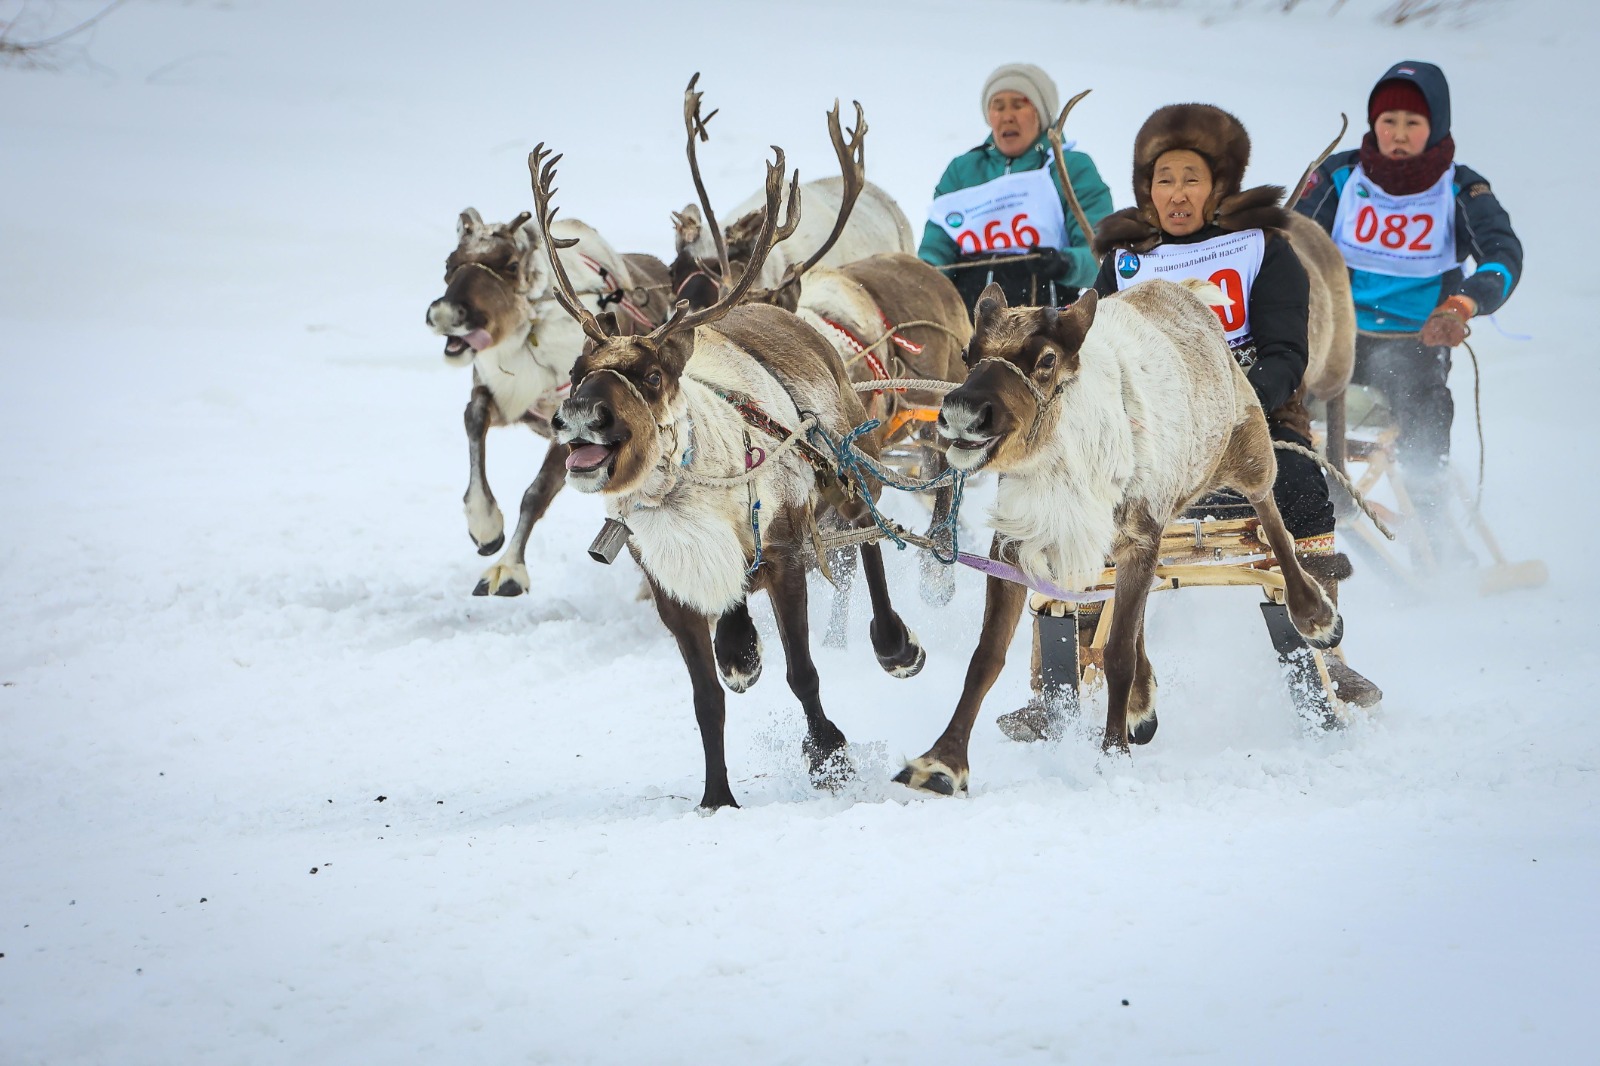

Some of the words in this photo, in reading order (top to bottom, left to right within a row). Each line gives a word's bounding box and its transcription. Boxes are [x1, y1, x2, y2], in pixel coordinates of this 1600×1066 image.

[956, 213, 1040, 255] 066
[1355, 205, 1434, 251] 082
[1154, 251, 1218, 273] национальный
[1219, 243, 1249, 259] наслег
